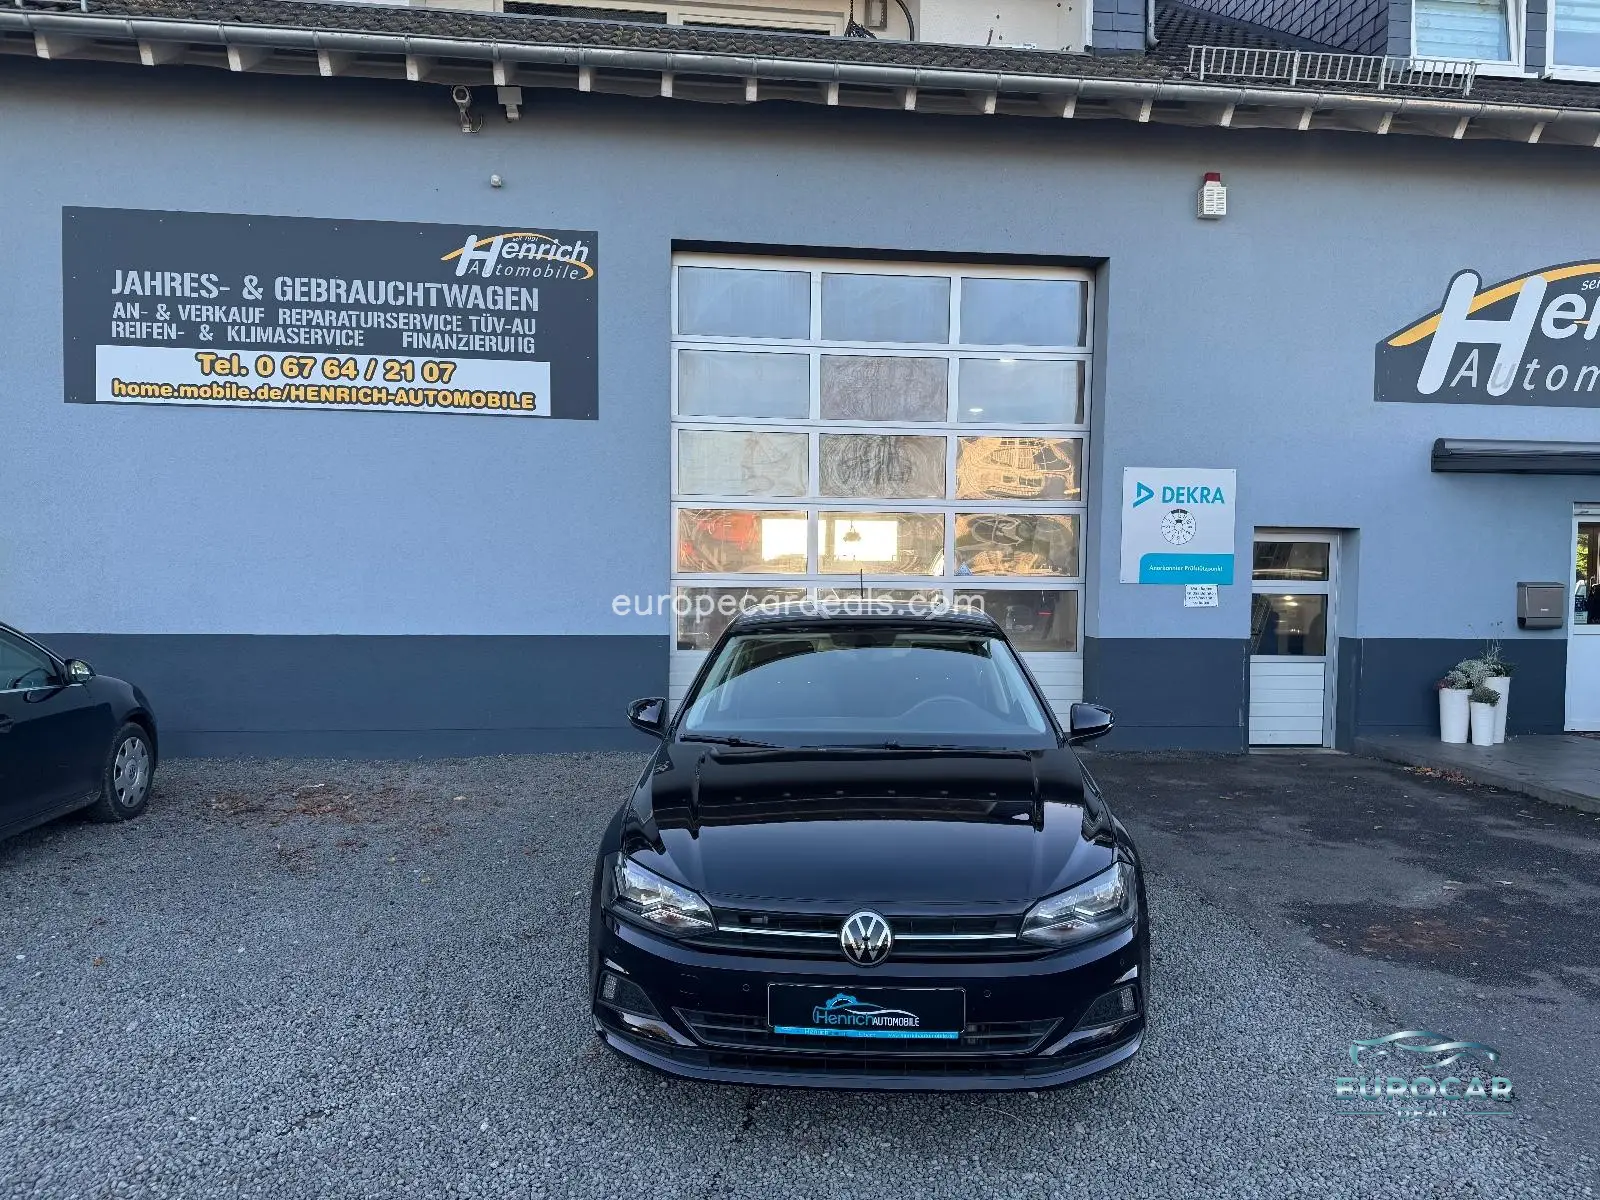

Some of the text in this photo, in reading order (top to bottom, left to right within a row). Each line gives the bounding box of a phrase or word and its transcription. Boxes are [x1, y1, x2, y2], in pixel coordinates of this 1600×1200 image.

[455, 234, 588, 277] Henrich
[111, 269, 539, 312] JAHRES- & GEBRAUCHTWAGEN
[111, 321, 185, 340] REIFEN-
[199, 324, 214, 341] &
[227, 325, 365, 347] KLIMASERVICE
[112, 301, 536, 335] AN- & VERKAUF REPARATURSERVICE TÜV-AU
[195, 352, 457, 384] Tel. 0 67 64 / 21 07
[111, 377, 536, 411] home.mobile.de/HENRICH-AUTOMOBILE
[1162, 486, 1225, 504] DEKRA
[815, 1010, 920, 1027] Henrich AUTOMOBILE
